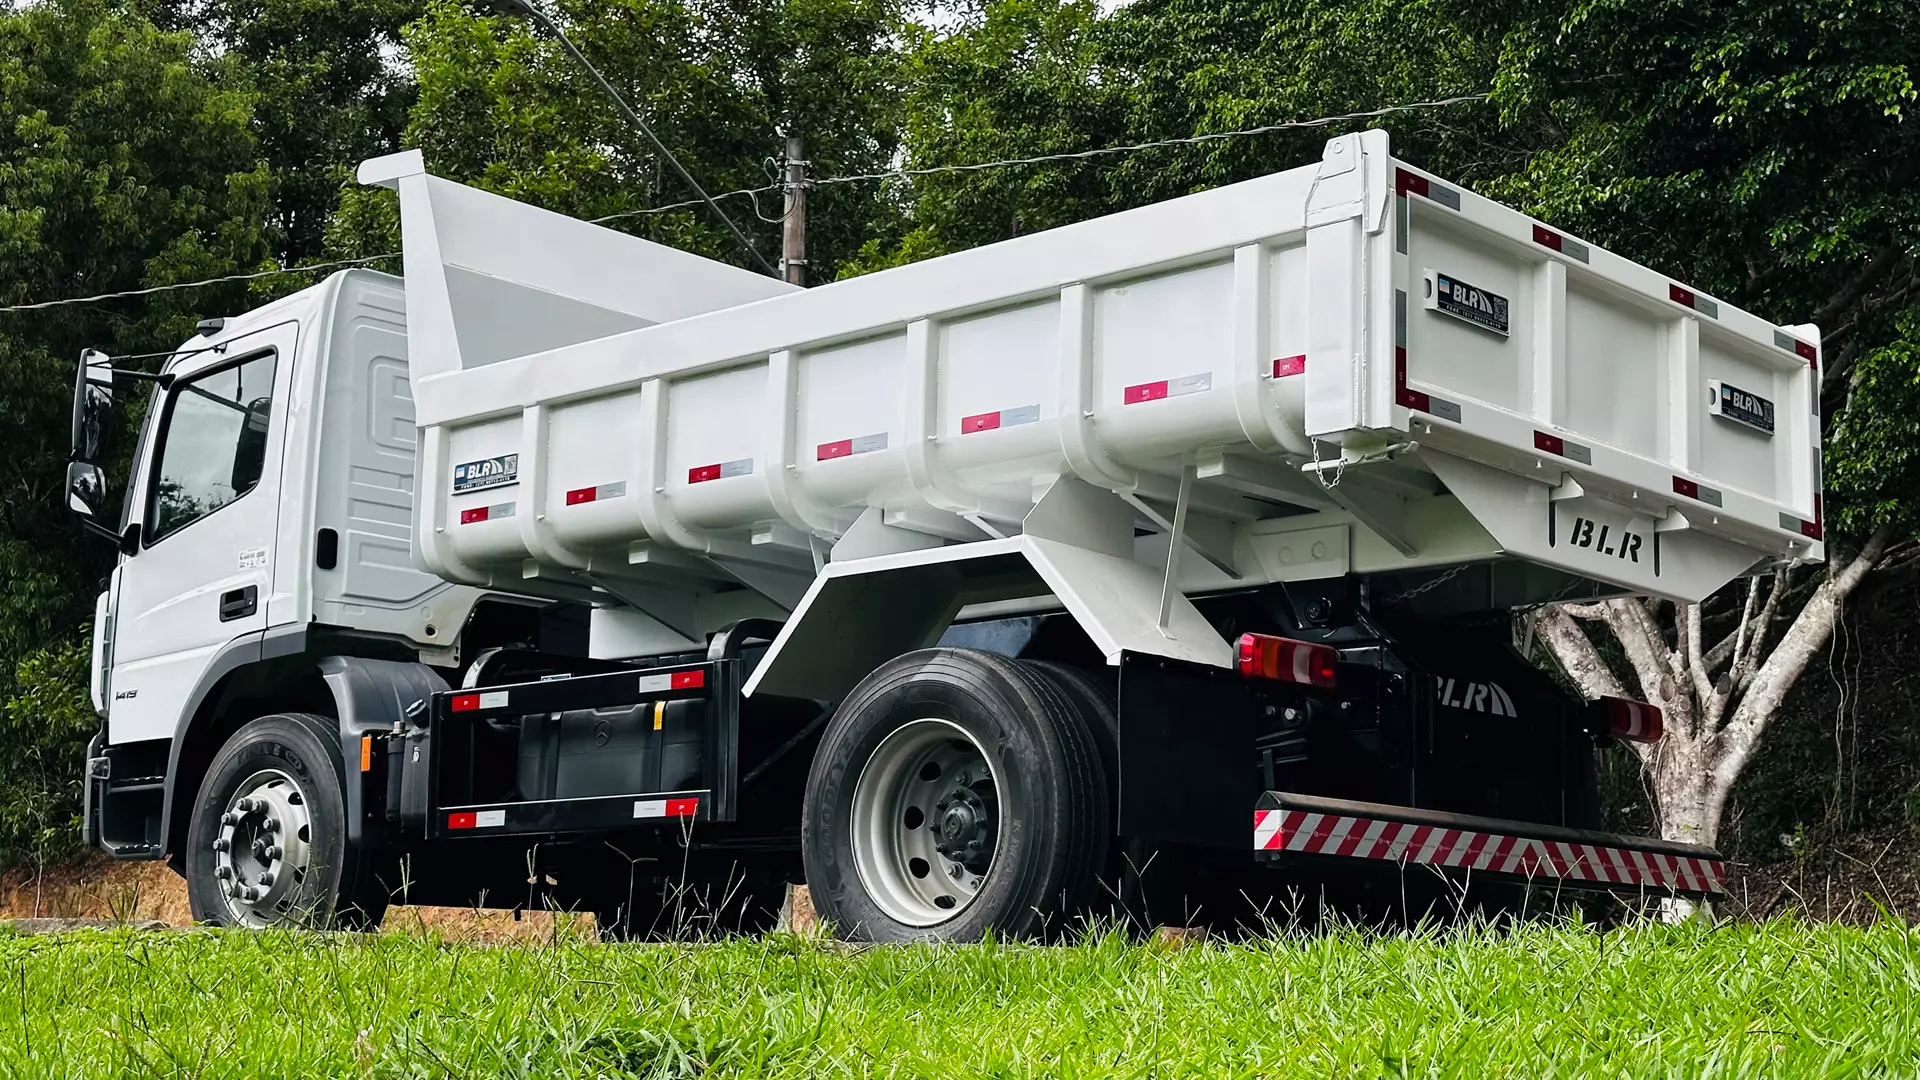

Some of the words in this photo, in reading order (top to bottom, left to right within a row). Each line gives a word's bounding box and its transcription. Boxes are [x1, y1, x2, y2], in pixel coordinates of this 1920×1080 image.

[1453, 284, 1478, 309] BLR
[1733, 391, 1752, 412] BLR
[467, 462, 491, 479] BLR
[1570, 517, 1642, 563] BLR
